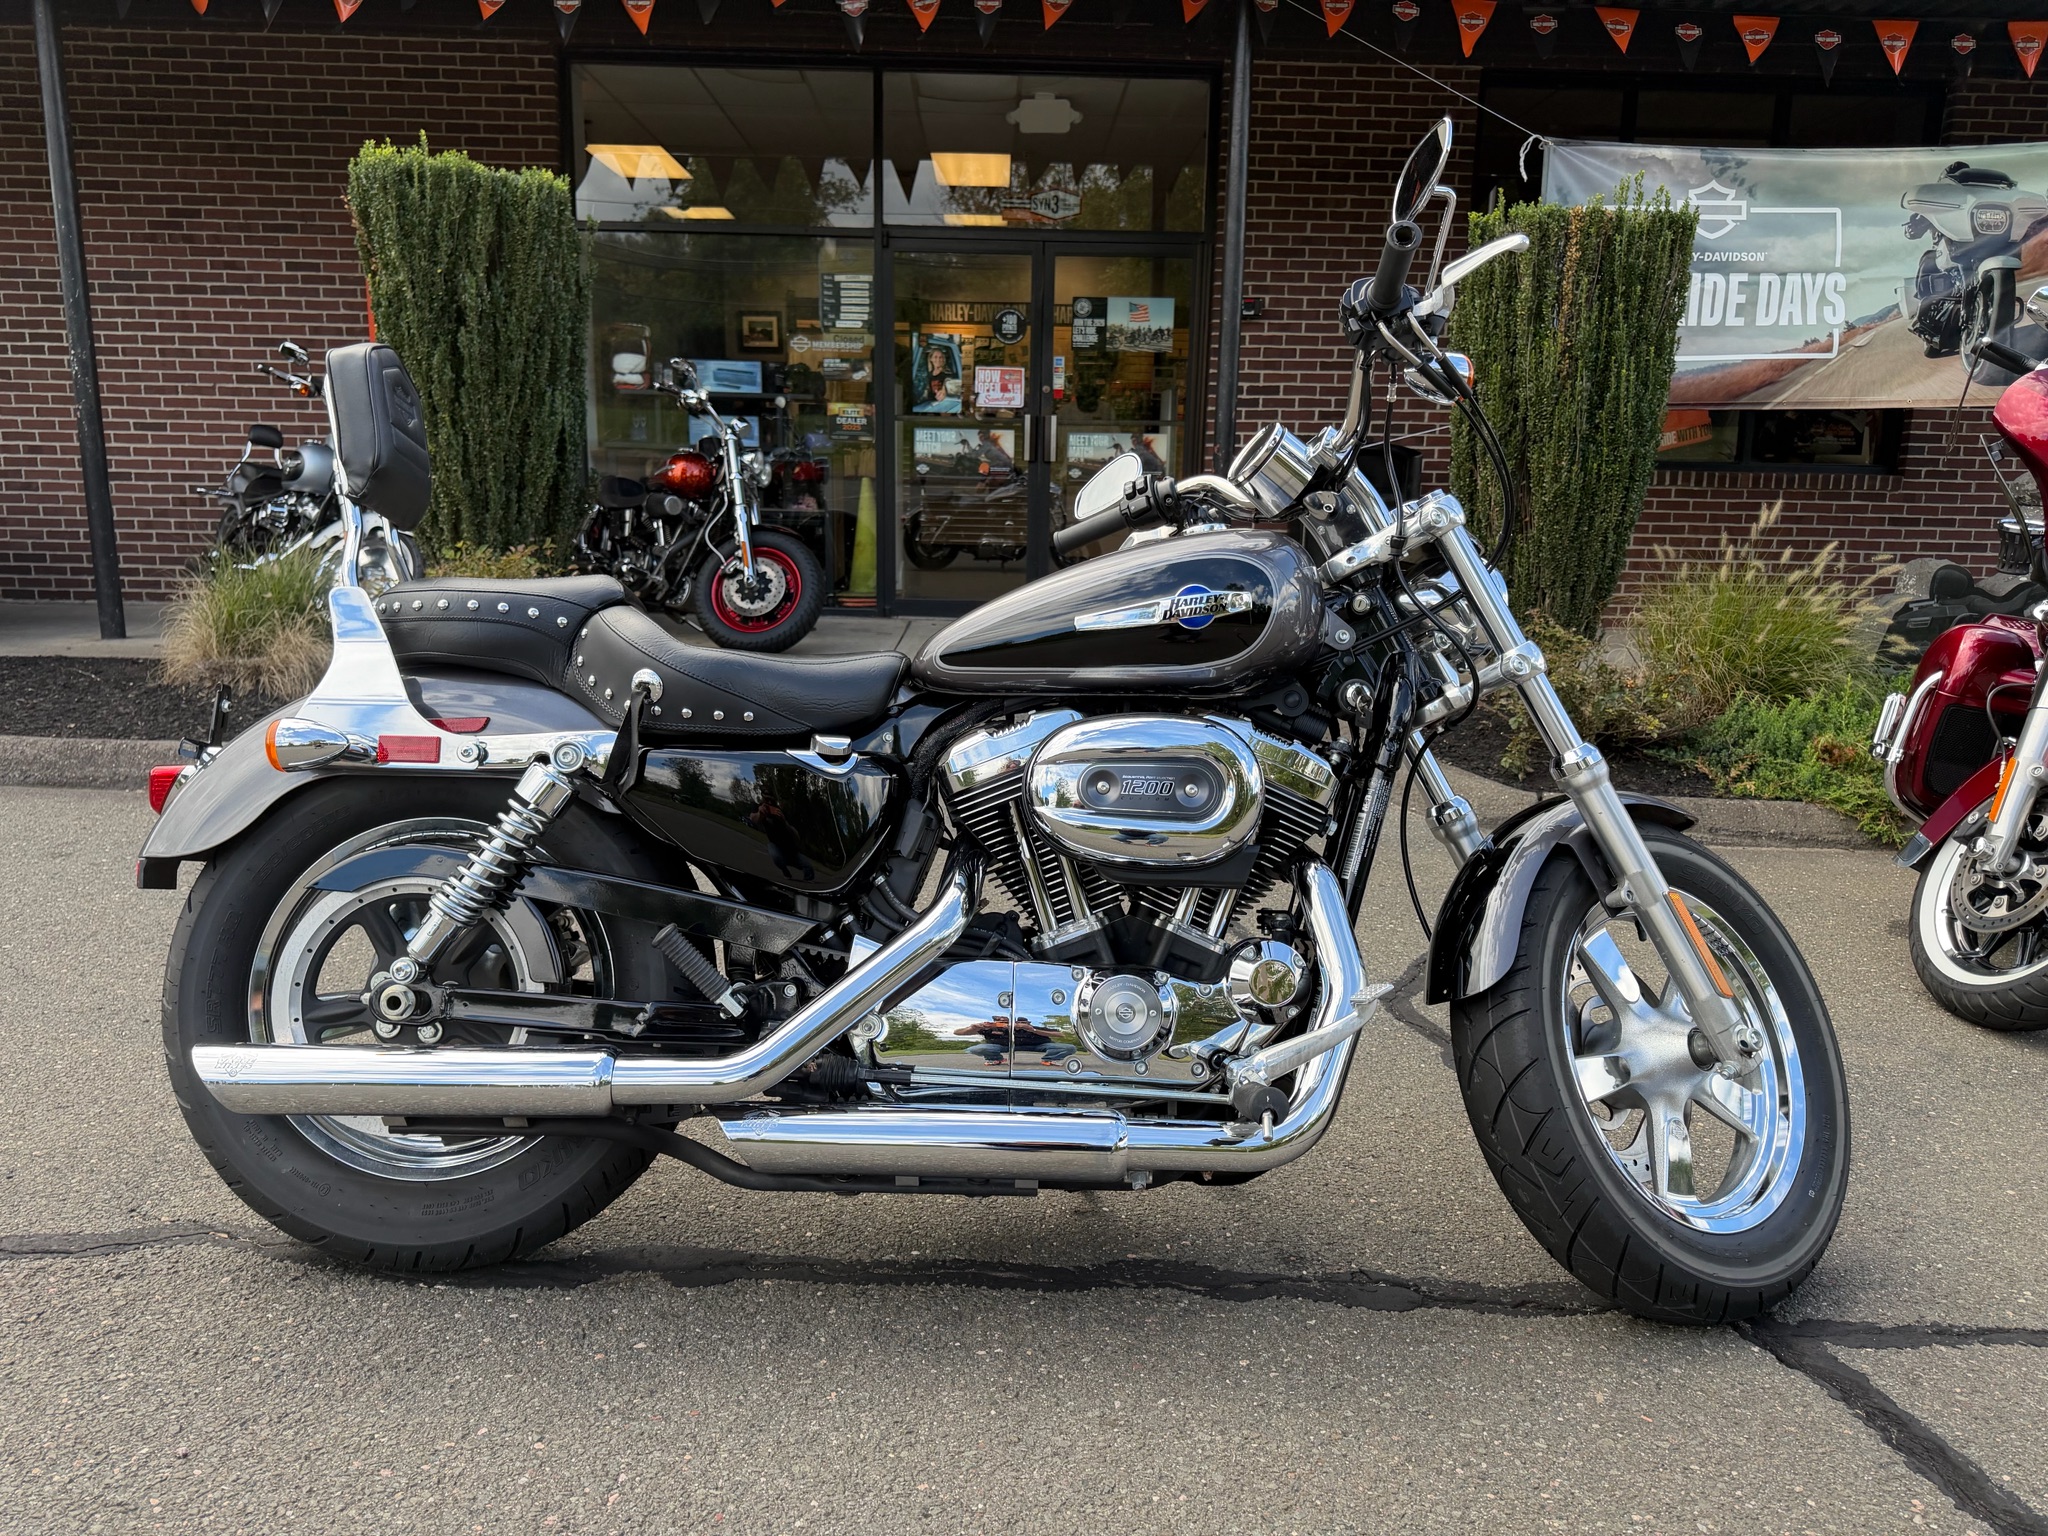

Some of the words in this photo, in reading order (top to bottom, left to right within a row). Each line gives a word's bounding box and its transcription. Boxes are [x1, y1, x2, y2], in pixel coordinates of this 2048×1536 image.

[1033, 195, 1059, 214] SYN3
[1677, 272, 1749, 327] IDE
[1755, 272, 1847, 326] DAYS
[979, 370, 1000, 382] NOW
[978, 383, 1000, 393] OPEN
[836, 417, 867, 425] DEALER
[916, 430, 937, 441] MEET
[937, 431, 956, 442] YOUR
[1677, 425, 1697, 441] WITH
[1069, 434, 1089, 446] MEET
[1090, 435, 1109, 446] YOUR
[916, 442, 941, 453] MATCH
[1069, 446, 1094, 458] MATCH
[1163, 603, 1228, 621] DAVIDSON
[1121, 780, 1175, 796] 1200
[1680, 865, 1766, 935] SHINKO
